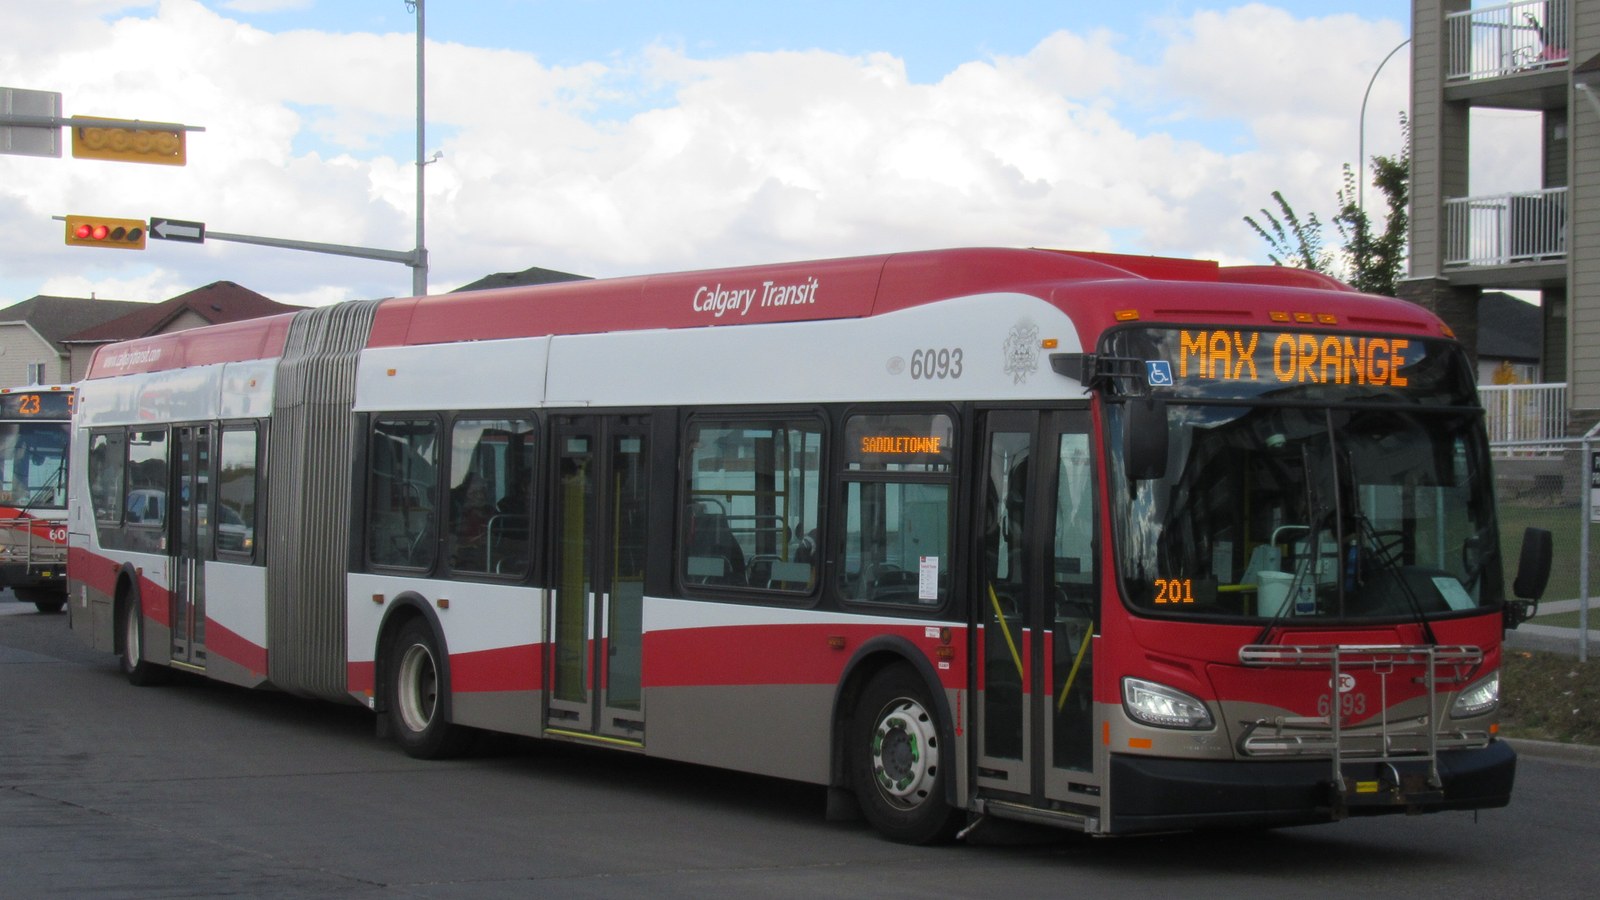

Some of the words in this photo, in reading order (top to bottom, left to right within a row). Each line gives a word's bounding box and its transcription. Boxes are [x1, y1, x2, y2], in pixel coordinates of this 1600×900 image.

[693, 283, 756, 318] Calgary
[761, 276, 818, 307] Transit
[910, 347, 963, 380] 6093
[1179, 330, 1258, 380] MAX
[1273, 333, 1409, 387] ORANGE
[19, 394, 41, 414] 23
[861, 436, 941, 454] SADDLETOWNE
[1154, 579, 1194, 603] 201
